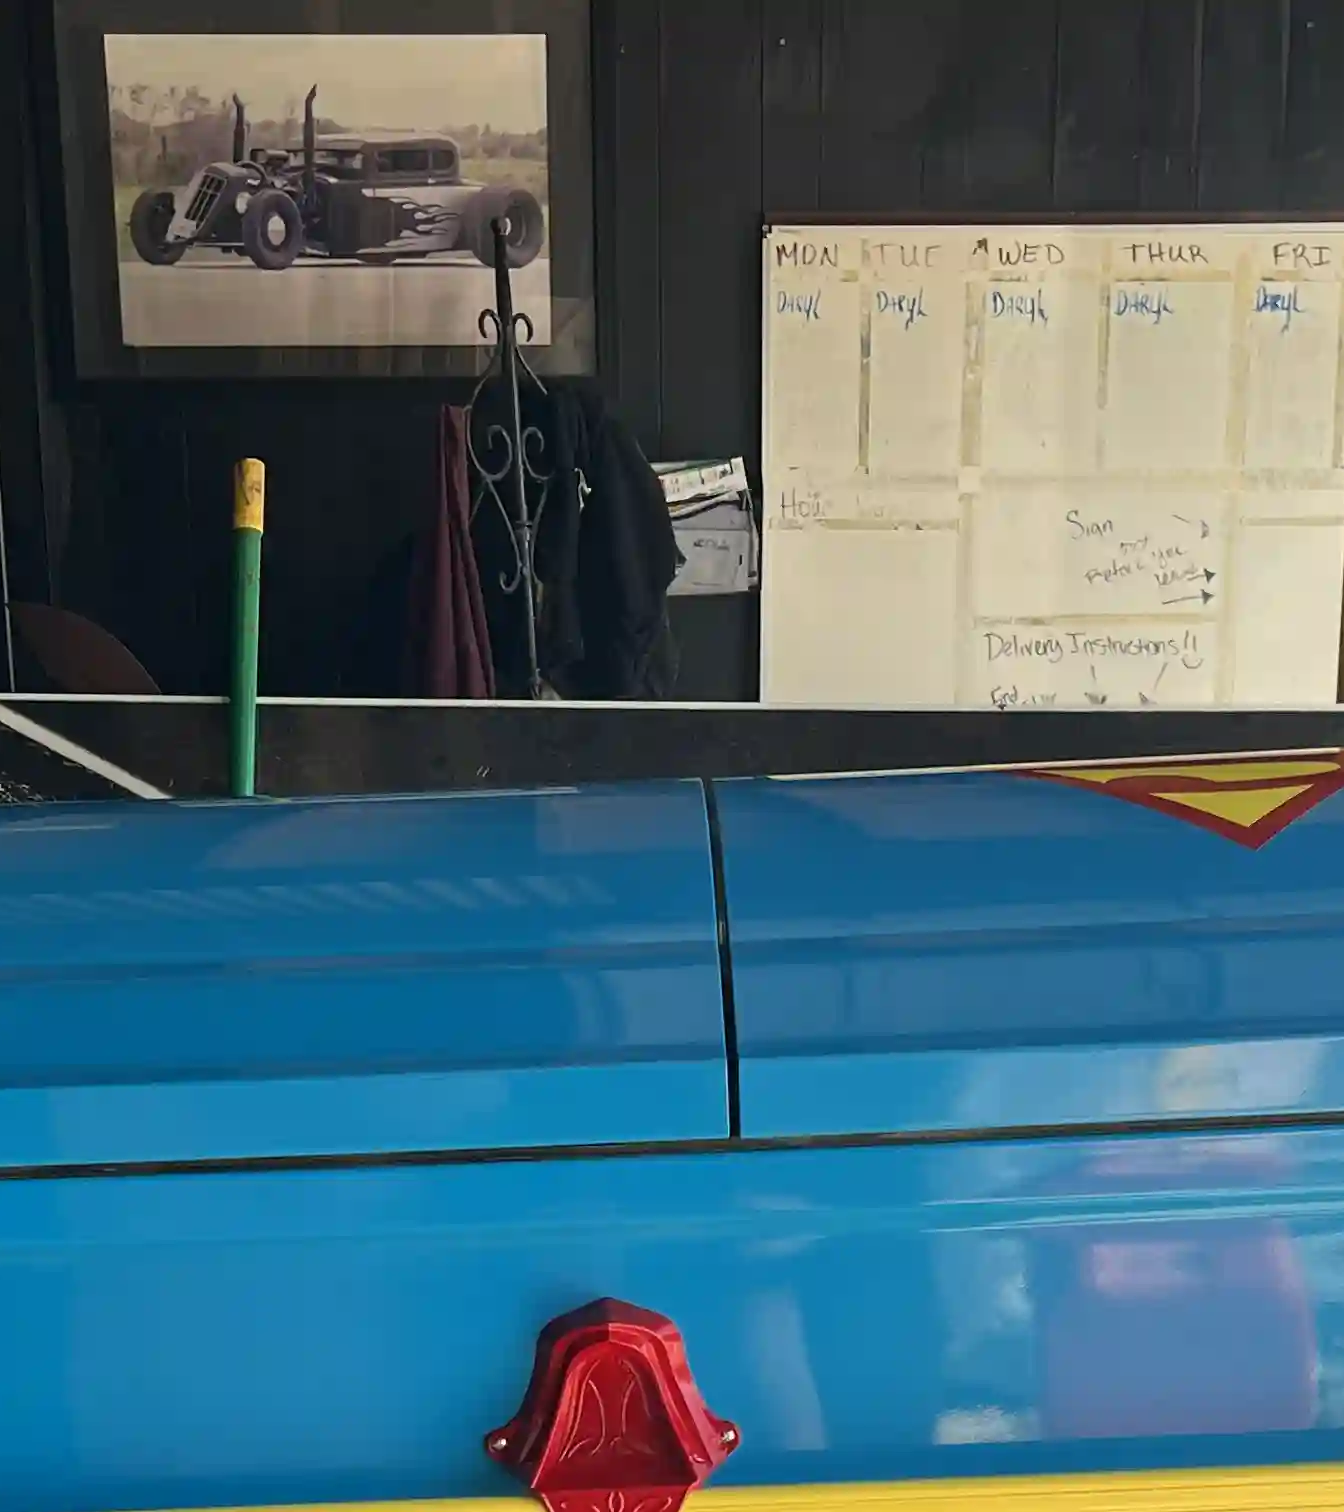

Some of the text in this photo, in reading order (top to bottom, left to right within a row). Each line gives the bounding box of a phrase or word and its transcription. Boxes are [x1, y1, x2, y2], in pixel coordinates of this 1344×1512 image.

[775, 242, 839, 268] MON
[997, 241, 1065, 266] WED
[1122, 242, 1209, 264] THUR
[1272, 242, 1332, 268] FRI
[984, 632, 1063, 664] Delivery
